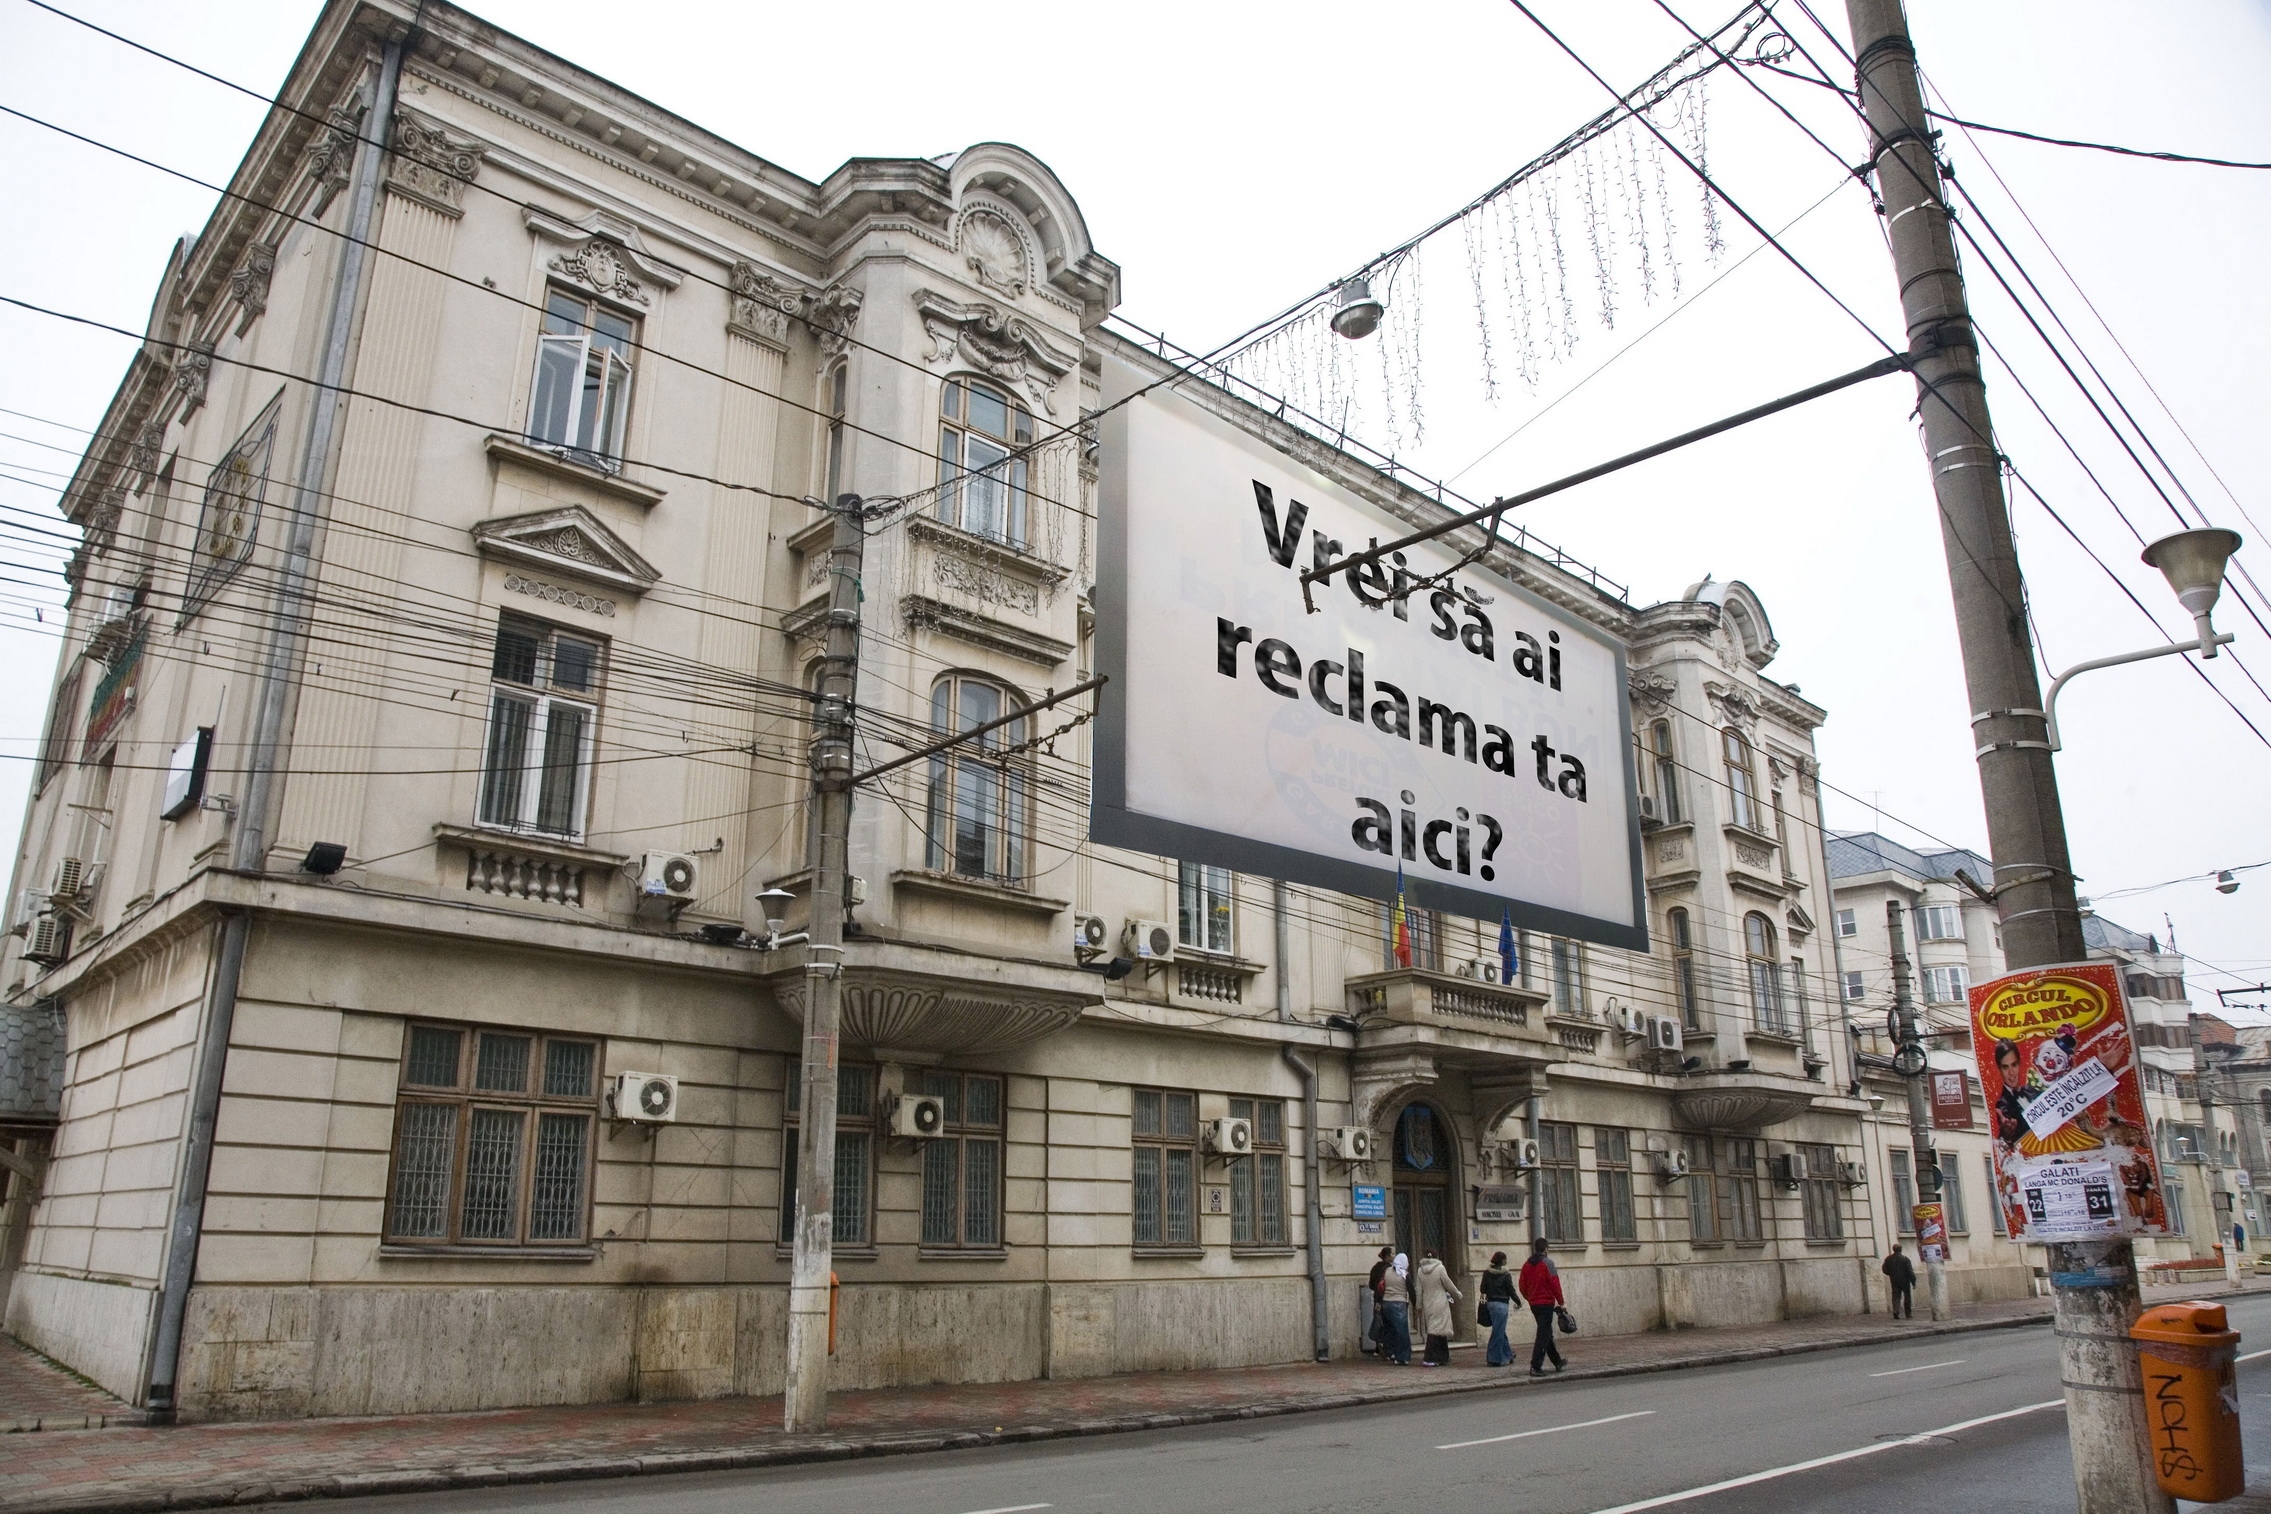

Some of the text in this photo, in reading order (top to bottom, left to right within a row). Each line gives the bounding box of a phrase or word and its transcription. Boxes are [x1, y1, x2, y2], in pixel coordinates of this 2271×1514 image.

[1252, 478, 1562, 692] Vrei să ai
[1217, 616, 1516, 778] reclama
[1531, 734, 1588, 804] ta
[1351, 789, 1503, 882] aici?
[1987, 998, 2096, 1028] ORLANDO
[1998, 989, 2071, 1011] CIRCUL
[2026, 1101, 2050, 1124] CIRCUL
[2044, 1087, 2066, 1108] ESTE
[2088, 1062, 2105, 1077] LA
[2024, 1180, 2048, 1188] LANGA
[2061, 1176, 2108, 1186] DONALD'S
[2040, 1167, 2080, 1179] GALATI
[2029, 1199, 2044, 1213] 22
[2089, 1195, 2108, 1209] 31
